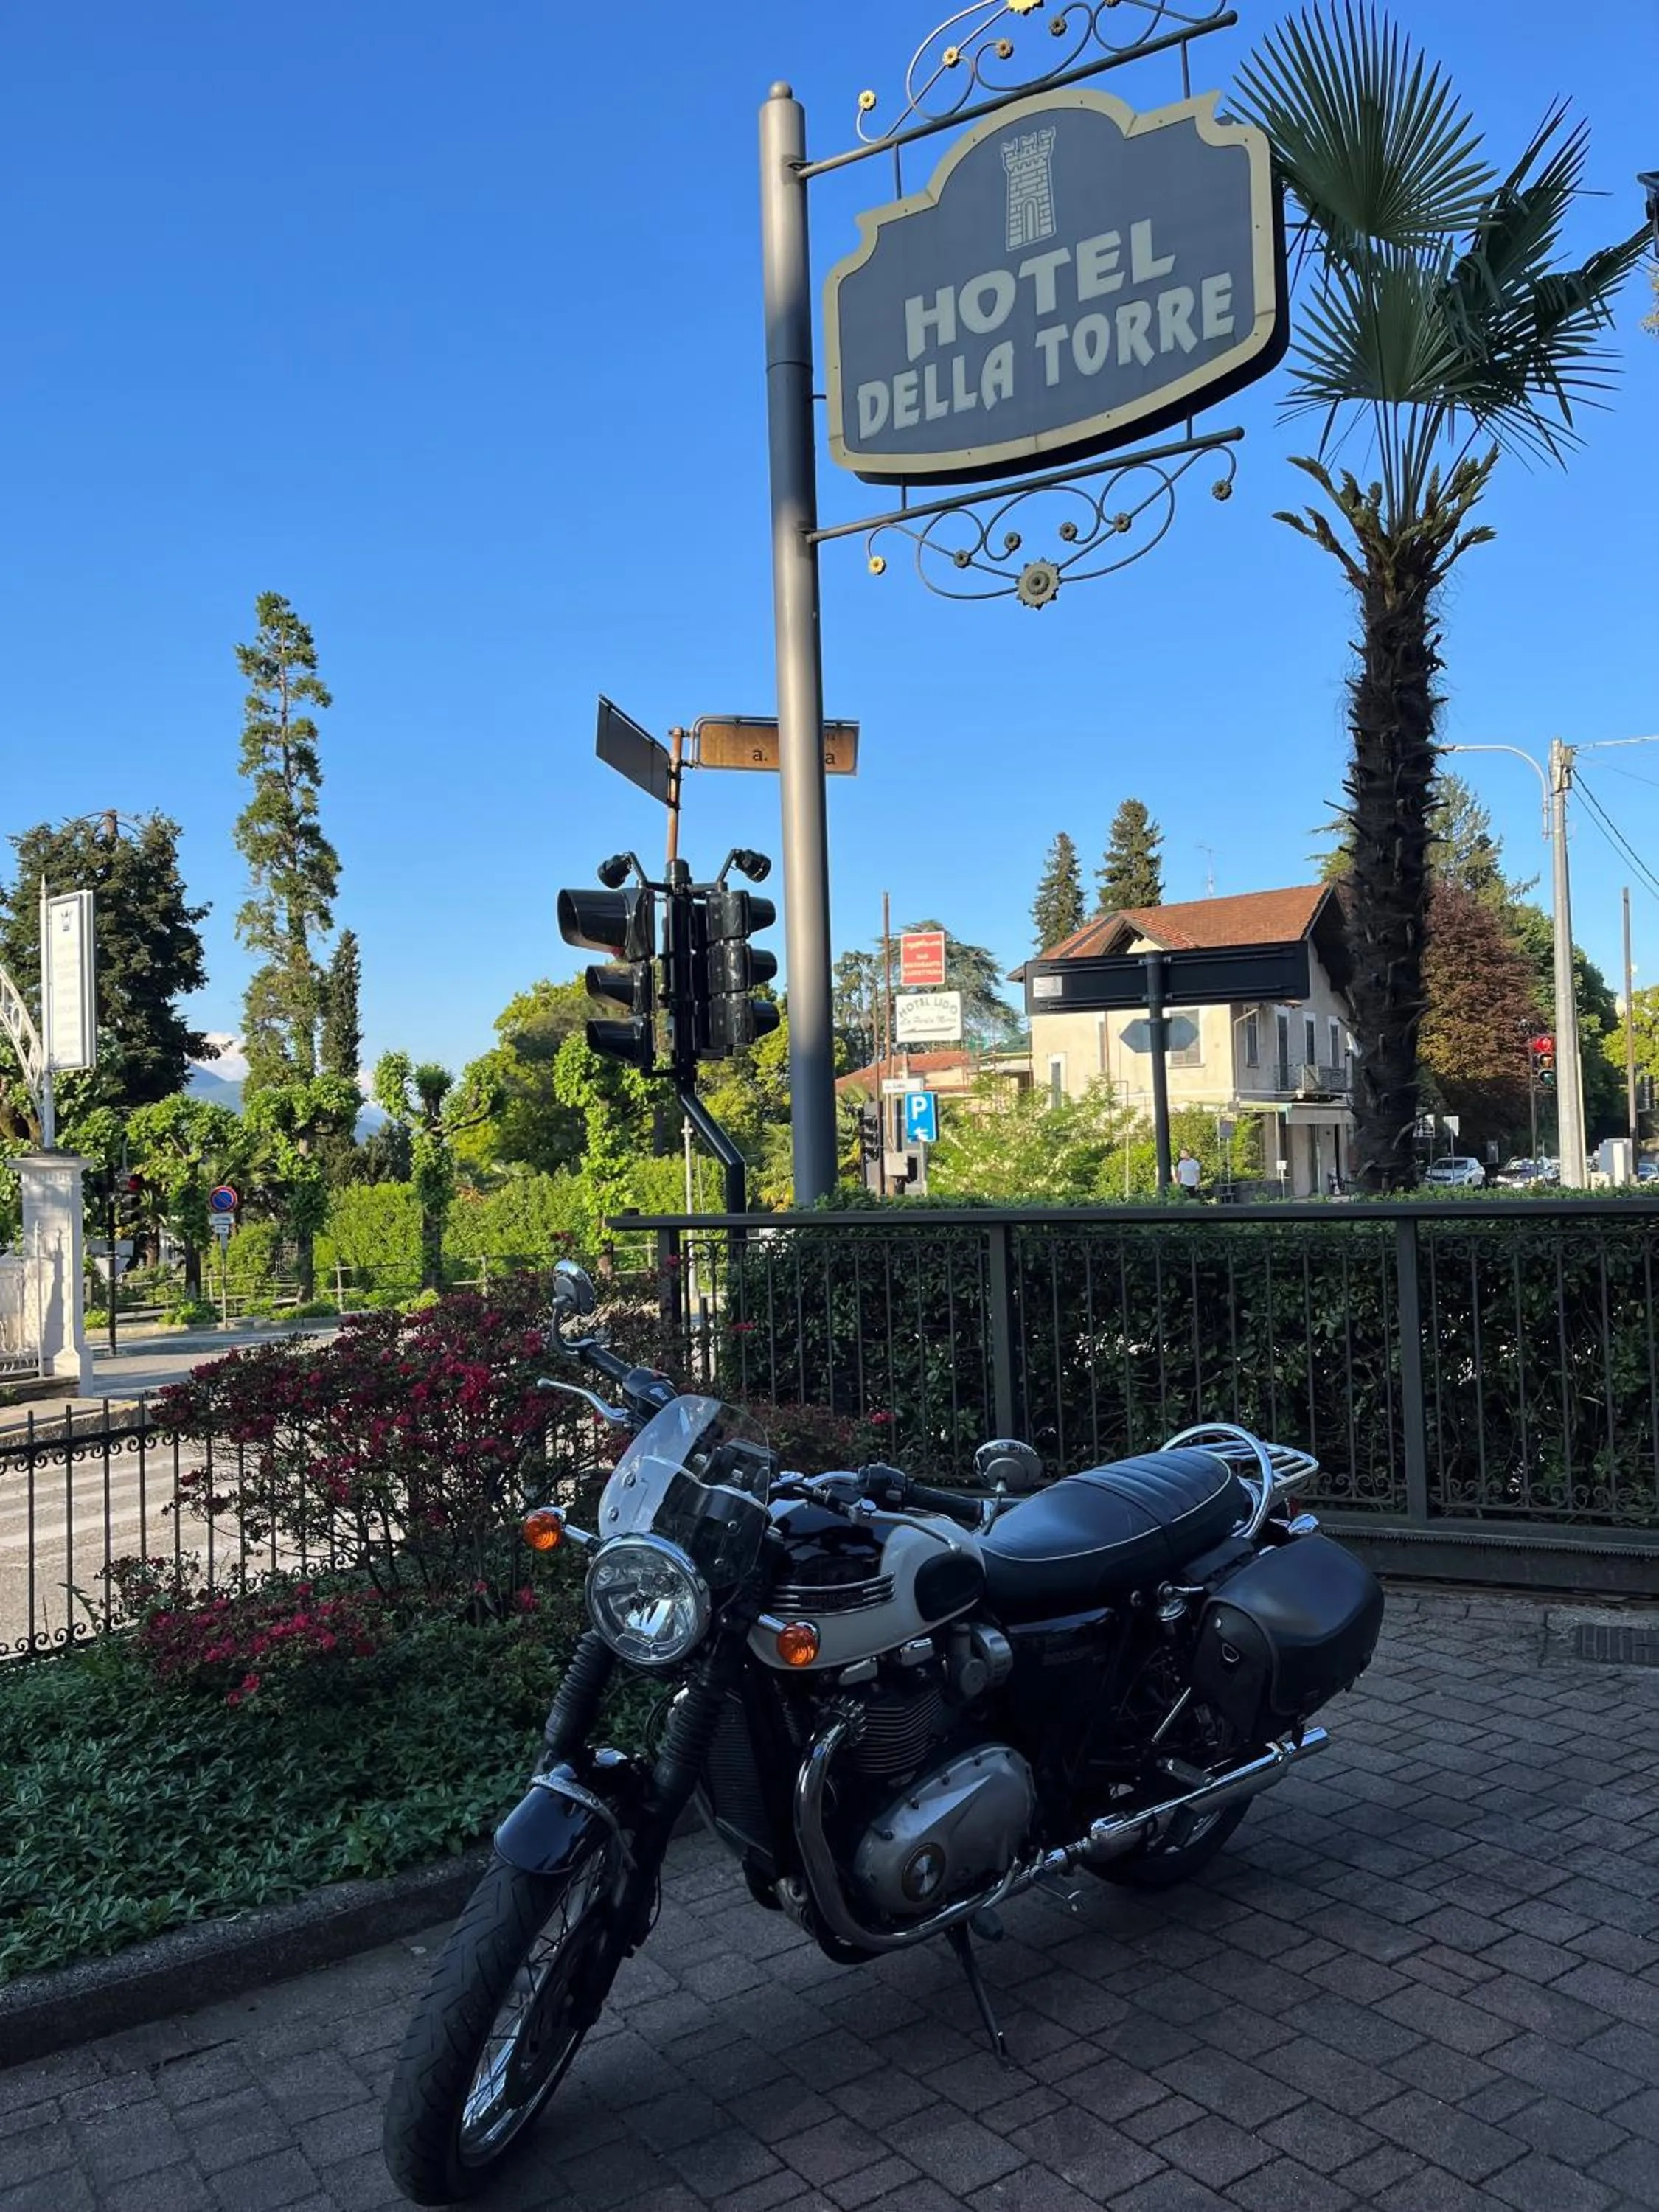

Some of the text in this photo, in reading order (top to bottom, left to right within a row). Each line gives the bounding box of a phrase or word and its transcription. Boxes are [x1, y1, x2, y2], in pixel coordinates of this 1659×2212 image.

[904, 218, 1176, 362] HOTEL
[856, 272, 1234, 440] DELLA TORRE
[898, 996, 958, 1018] HOTEL LIDO
[911, 1096, 928, 1121] P
